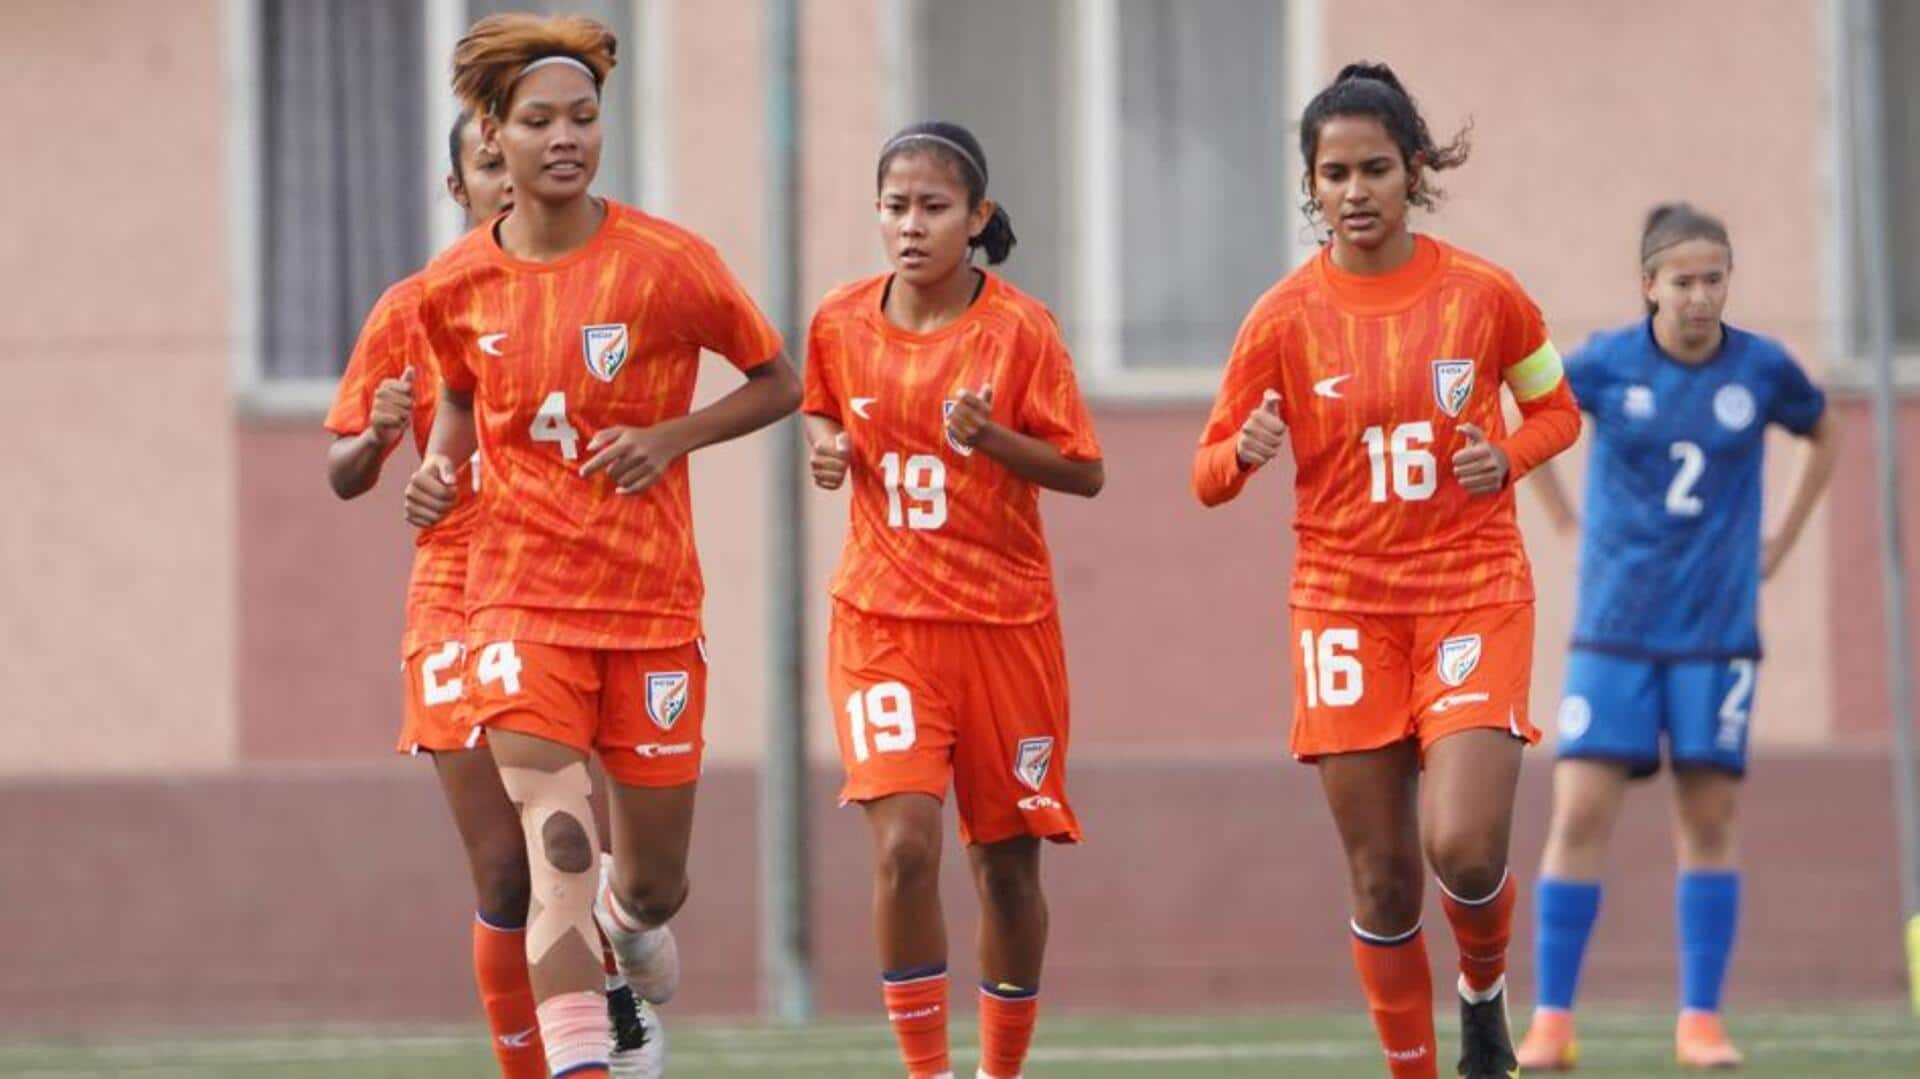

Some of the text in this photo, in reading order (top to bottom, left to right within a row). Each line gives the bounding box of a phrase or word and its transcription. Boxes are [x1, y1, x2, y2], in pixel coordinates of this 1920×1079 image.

[529, 391, 578, 461] 4
[1362, 420, 1437, 503] 16
[880, 452, 948, 529] 19
[1665, 441, 1705, 515] 2
[477, 640, 523, 695] 4
[1300, 627, 1364, 708] 16
[1719, 658, 1753, 722] 2
[845, 681, 916, 763] 19
